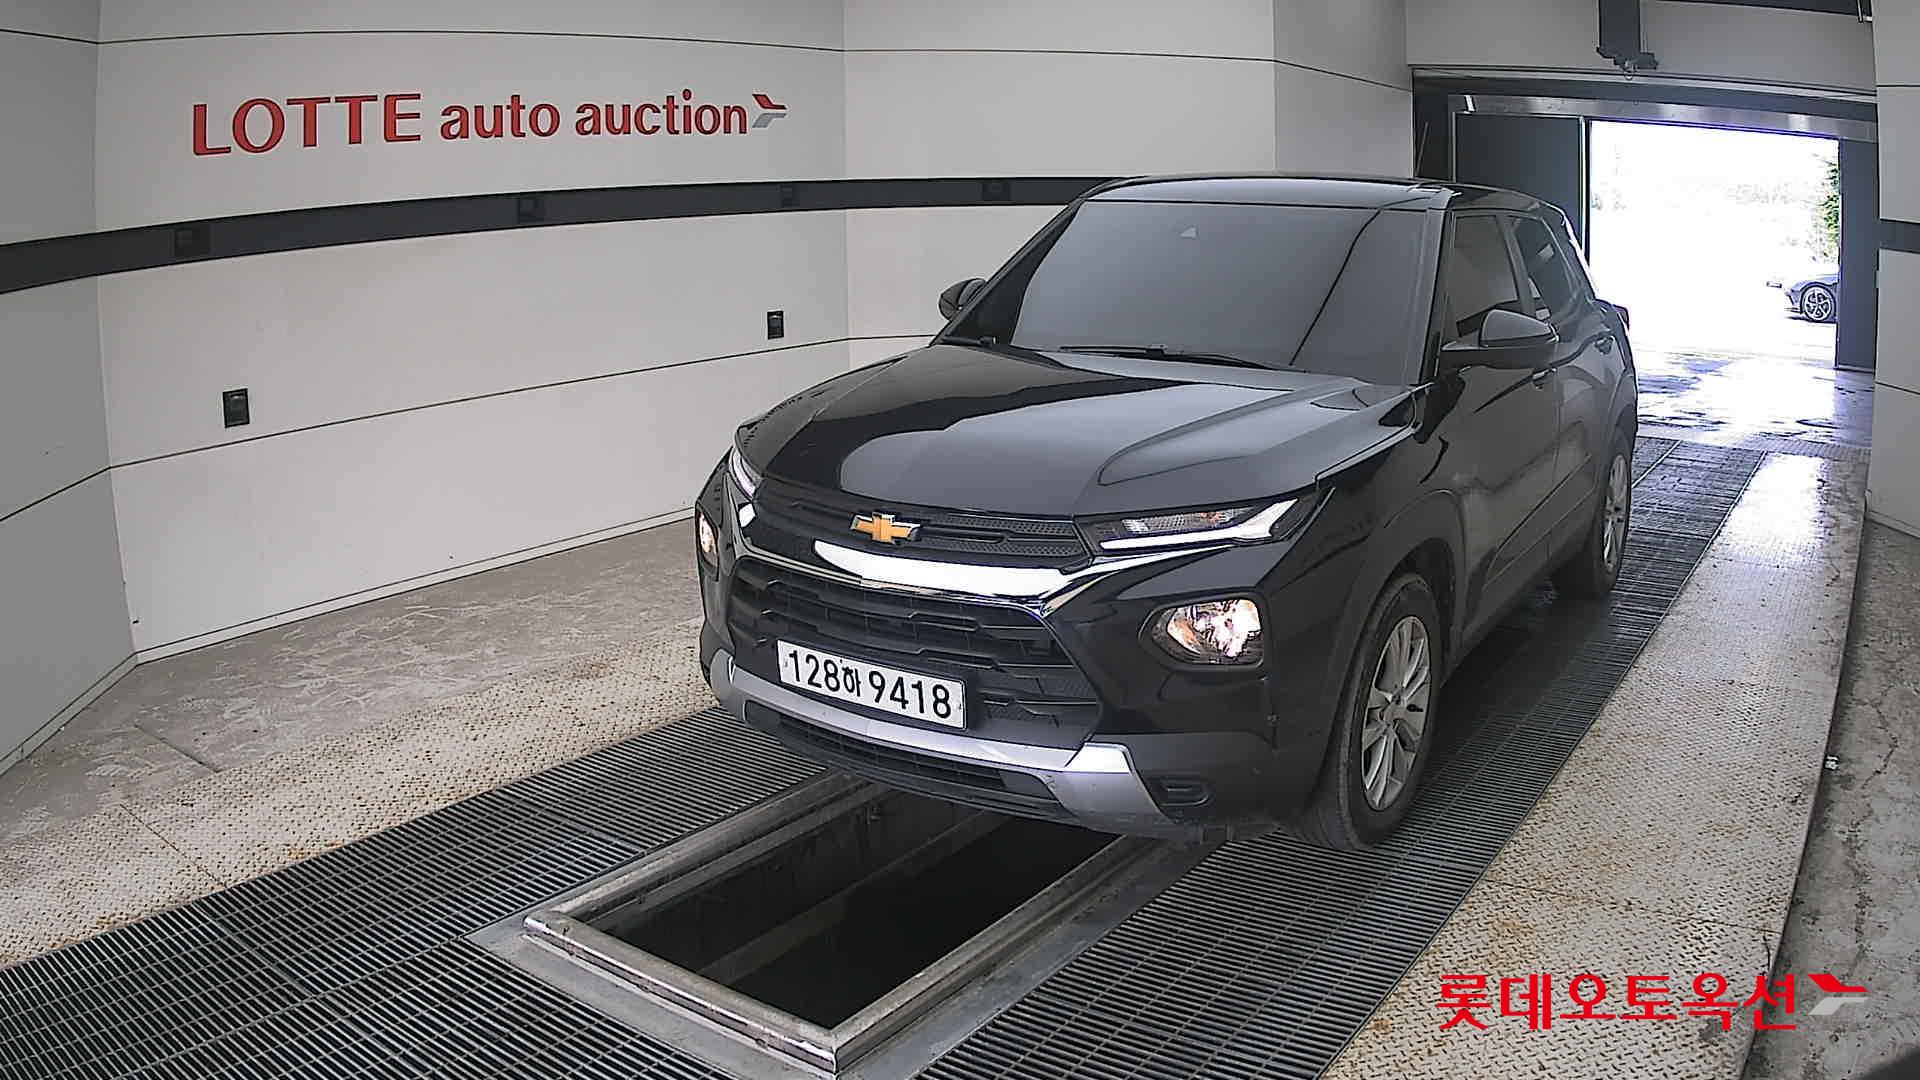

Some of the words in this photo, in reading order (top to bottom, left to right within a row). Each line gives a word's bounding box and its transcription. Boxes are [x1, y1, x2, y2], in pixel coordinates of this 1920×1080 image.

[192, 93, 421, 156] LOTTE
[439, 94, 560, 140] auto
[574, 88, 749, 136] auction
[868, 670, 951, 719] 9418
